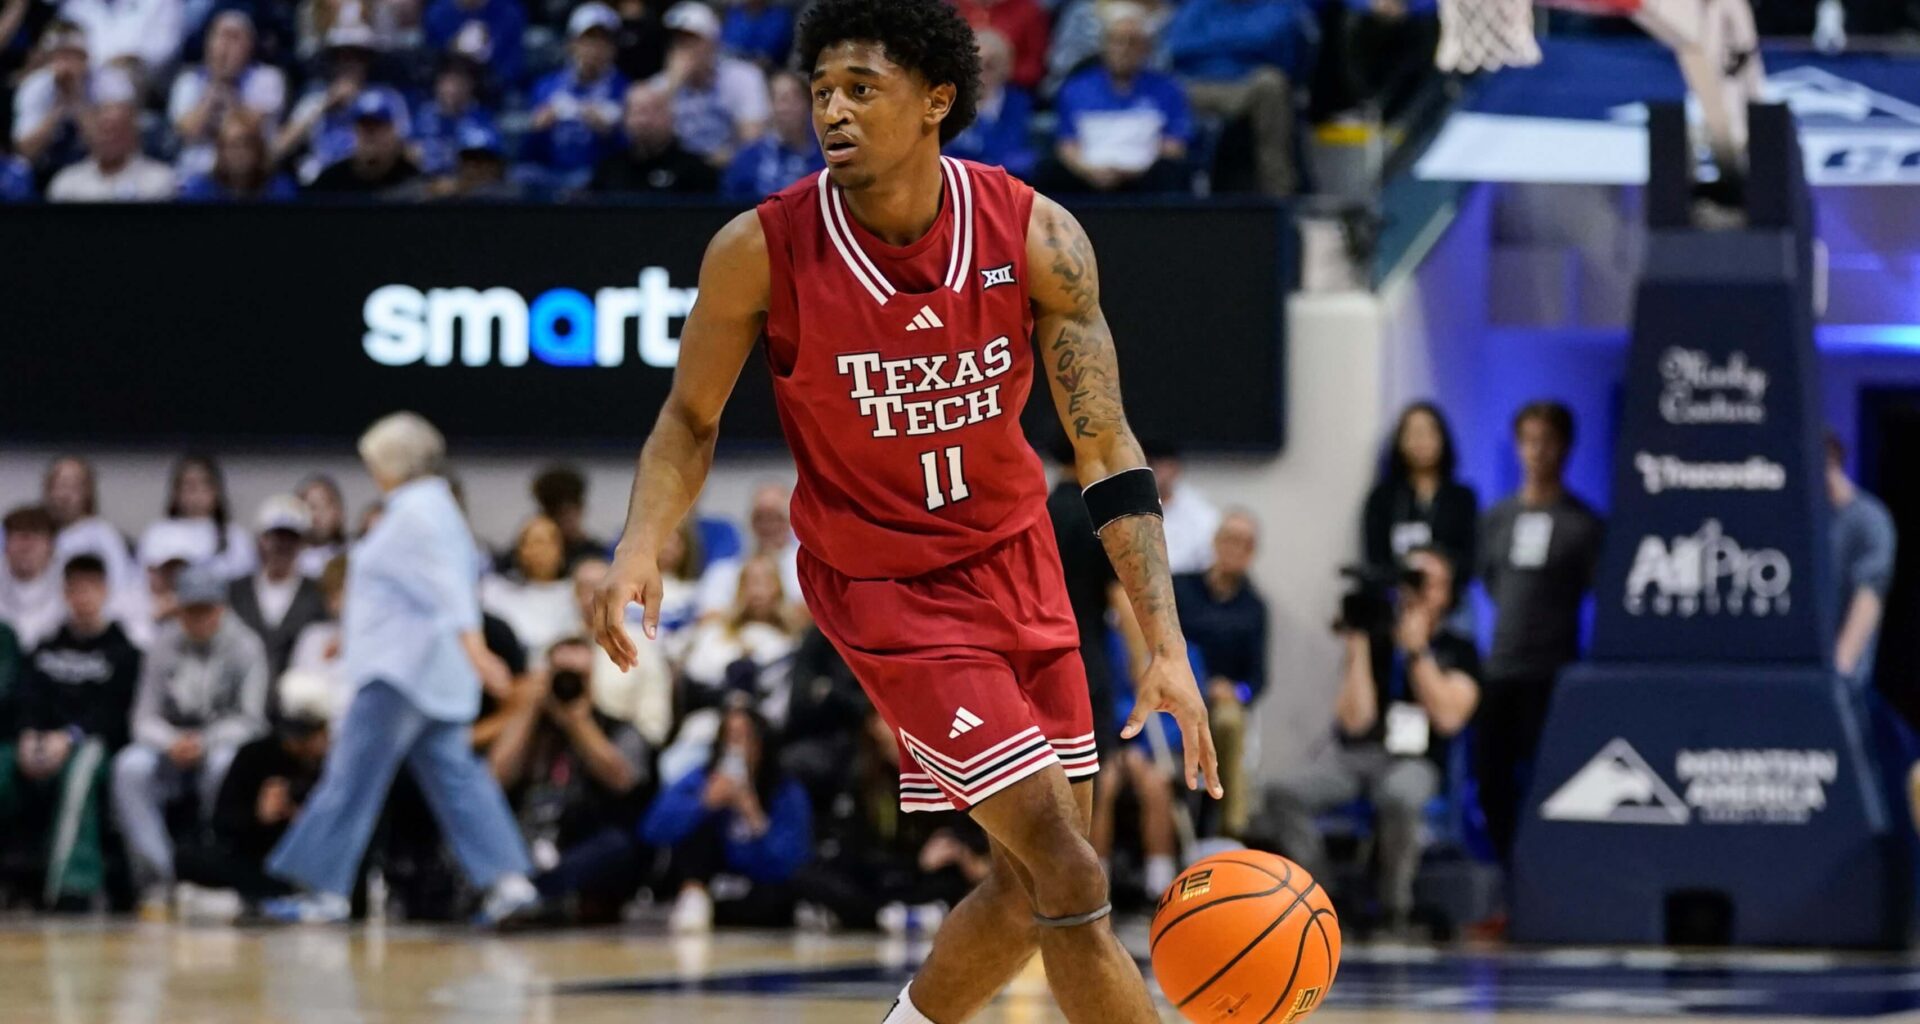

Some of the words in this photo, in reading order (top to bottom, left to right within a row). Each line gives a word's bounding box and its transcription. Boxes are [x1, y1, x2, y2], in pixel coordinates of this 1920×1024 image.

[362, 267, 698, 368] smart
[836, 336, 1012, 399] TEXAS
[859, 384, 1003, 438] TECH
[920, 446, 970, 511] 11
